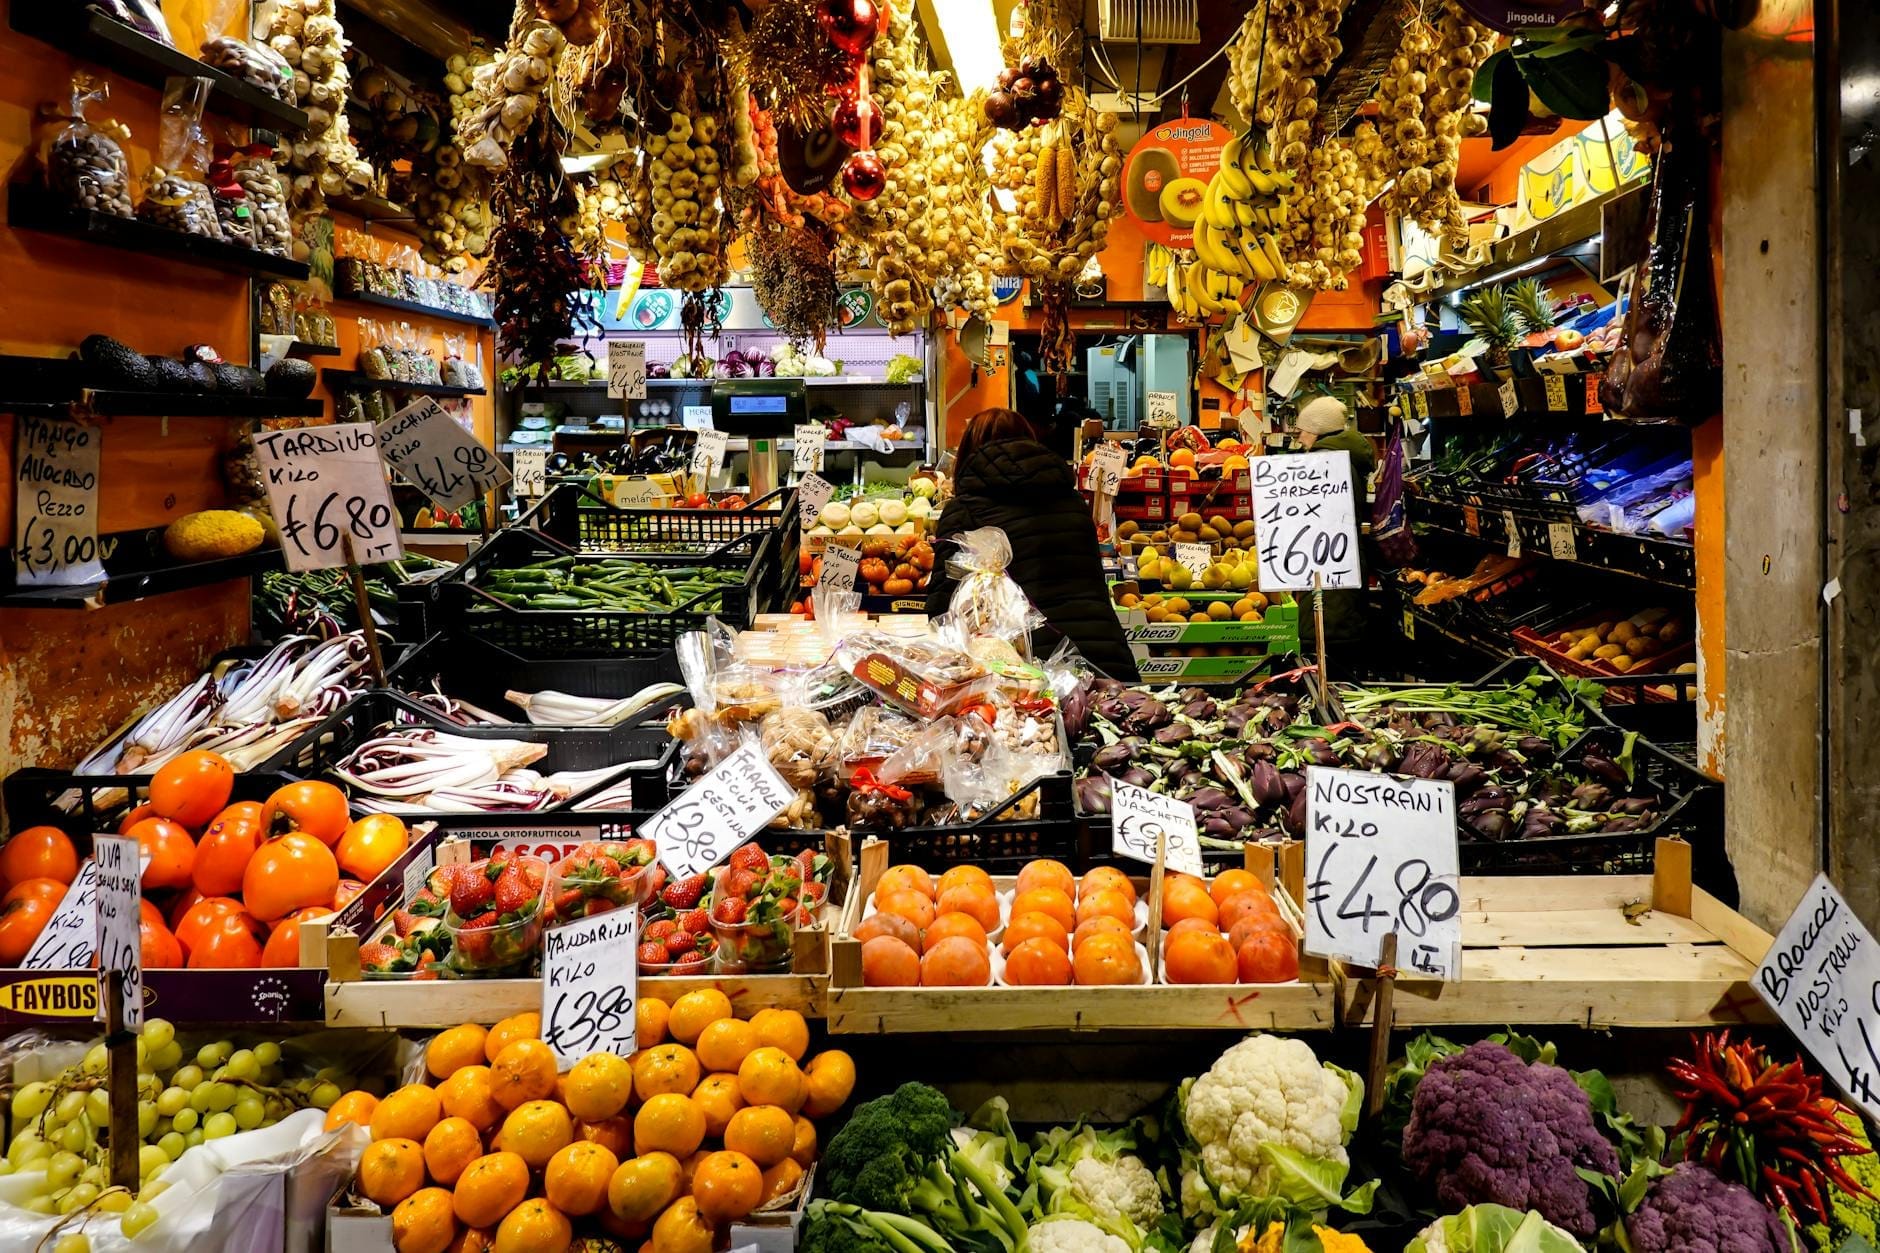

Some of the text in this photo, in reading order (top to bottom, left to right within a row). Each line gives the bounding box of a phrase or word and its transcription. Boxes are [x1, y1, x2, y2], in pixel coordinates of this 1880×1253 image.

[1506, 11, 1555, 24] jingold.it
[1172, 124, 1210, 141] Jingold
[23, 419, 89, 449] MANGO
[380, 403, 442, 447] UCCHINE
[258, 428, 376, 460] TARDIVO
[386, 440, 421, 463] KILO
[20, 454, 95, 490] AVOCADO
[269, 462, 319, 485] KILO
[1255, 461, 1329, 487] BOTOLI
[37, 490, 85, 516] PEZZO
[620, 495, 652, 504] melan
[1264, 480, 1349, 499] SARDEGNA
[17, 516, 95, 578] €3,00
[367, 543, 392, 558] IT
[731, 749, 785, 811] FRAGOLE
[1315, 776, 1444, 813] NOSTRANI
[702, 790, 746, 839] CESTINO
[1117, 798, 1193, 829] VASCHETTA
[1314, 810, 1379, 838] KILO
[454, 830, 499, 839] AGRICOLA
[503, 829, 582, 839] ORTOFRUTTICOLA
[97, 843, 121, 869] UVA
[1307, 841, 1460, 940] €4,80
[50, 909, 84, 930] KILO
[98, 895, 117, 920] KILO
[547, 912, 634, 960] MANDARINI
[1761, 884, 1840, 1006] BROCCOLI
[550, 957, 595, 987] KILO
[1796, 918, 1861, 1030] NOSTRANI
[11, 984, 96, 1011] FAYBOS
[258, 991, 284, 1001] Spania
[128, 1008, 139, 1024] IT
[545, 985, 633, 1056] €3,80
[1819, 998, 1849, 1038] KILO
